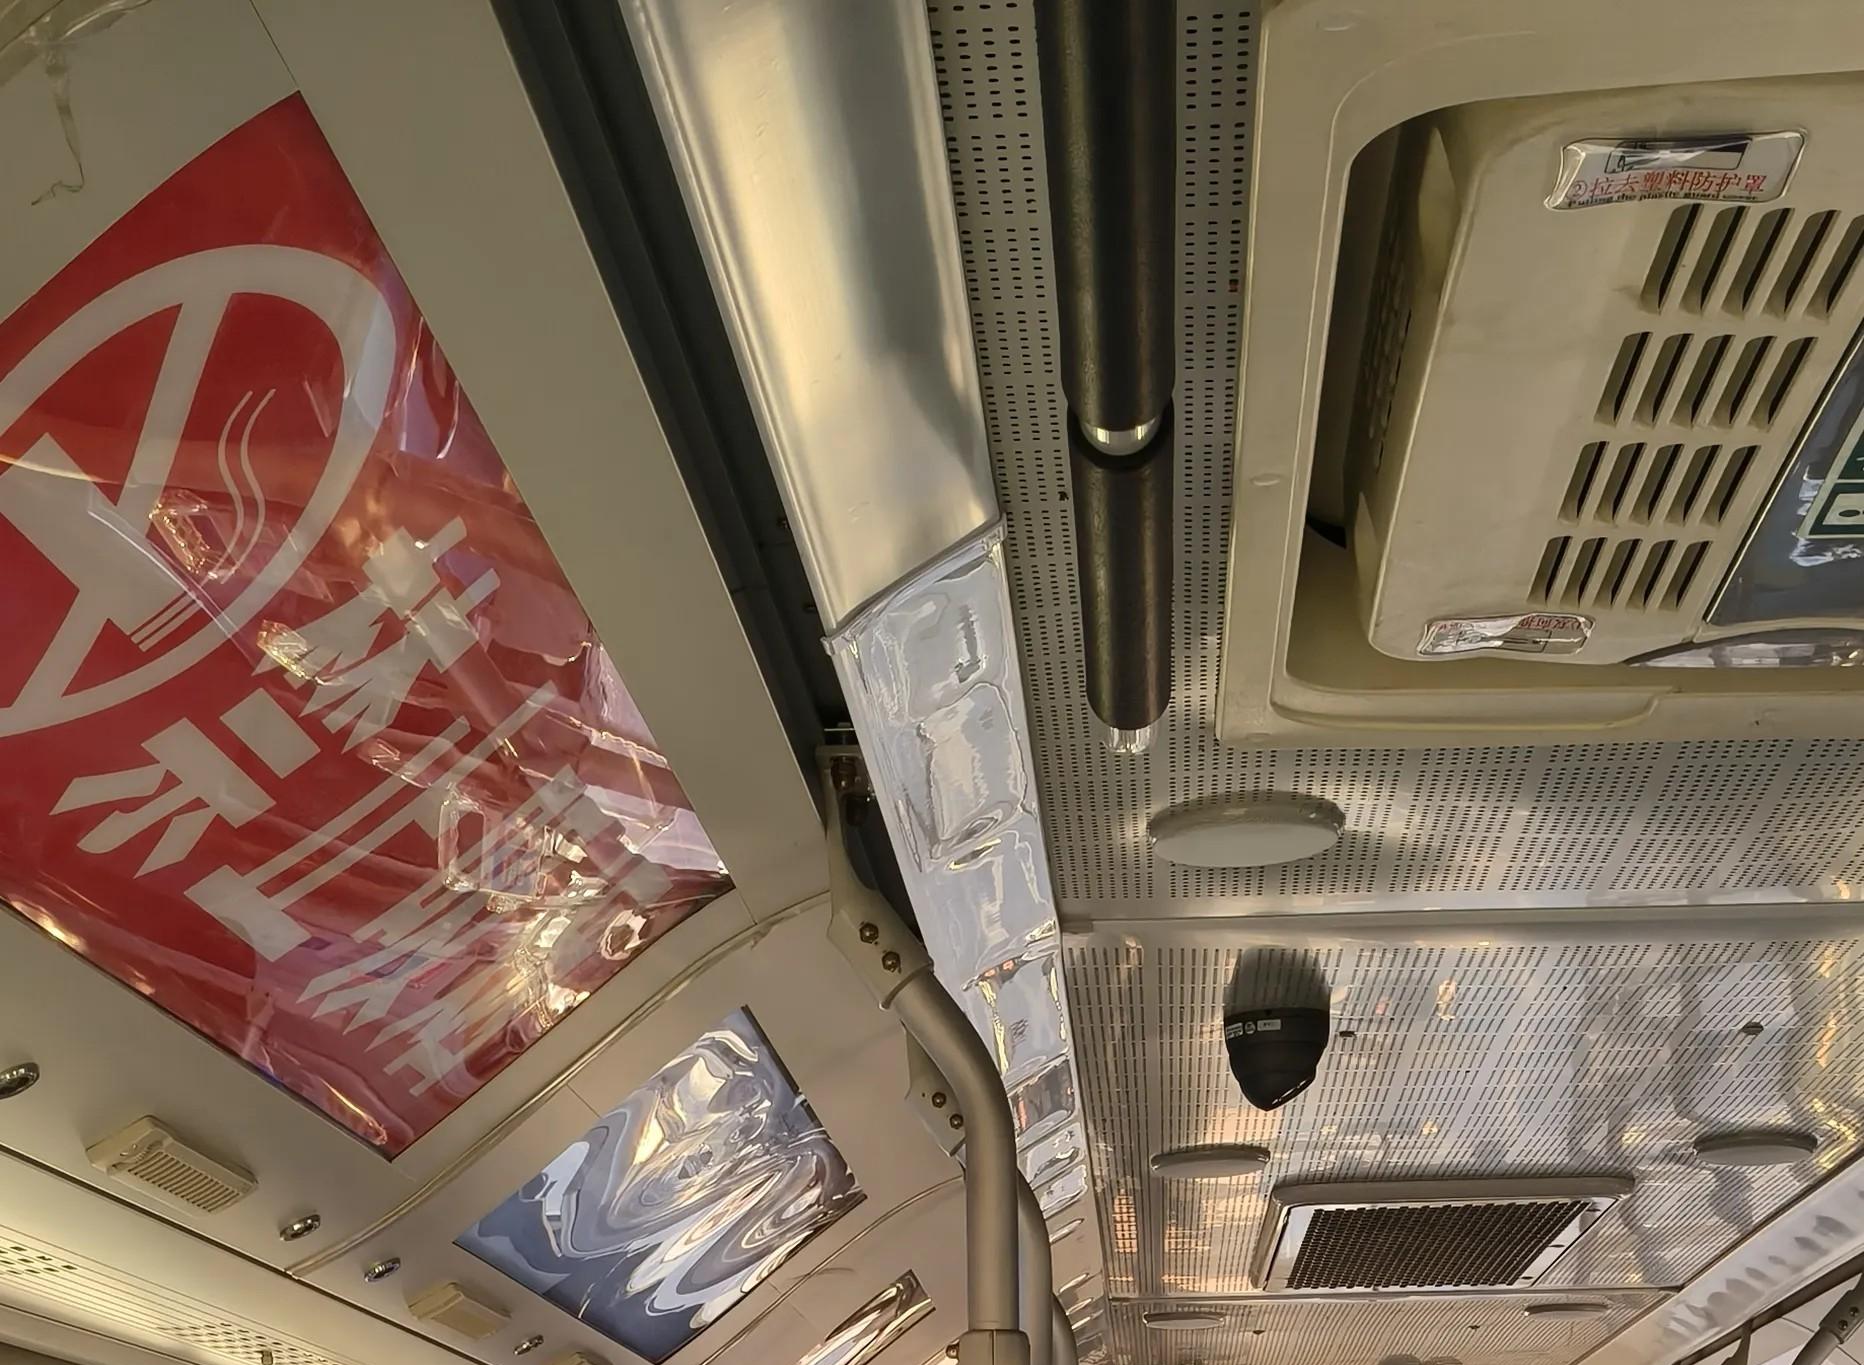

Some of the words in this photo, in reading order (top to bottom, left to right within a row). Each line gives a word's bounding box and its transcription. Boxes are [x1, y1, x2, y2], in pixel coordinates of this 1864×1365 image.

[1617, 192, 1637, 202] the
[1638, 189, 1680, 202] plastic
[50, 517, 675, 1096] 禁止吸烟
